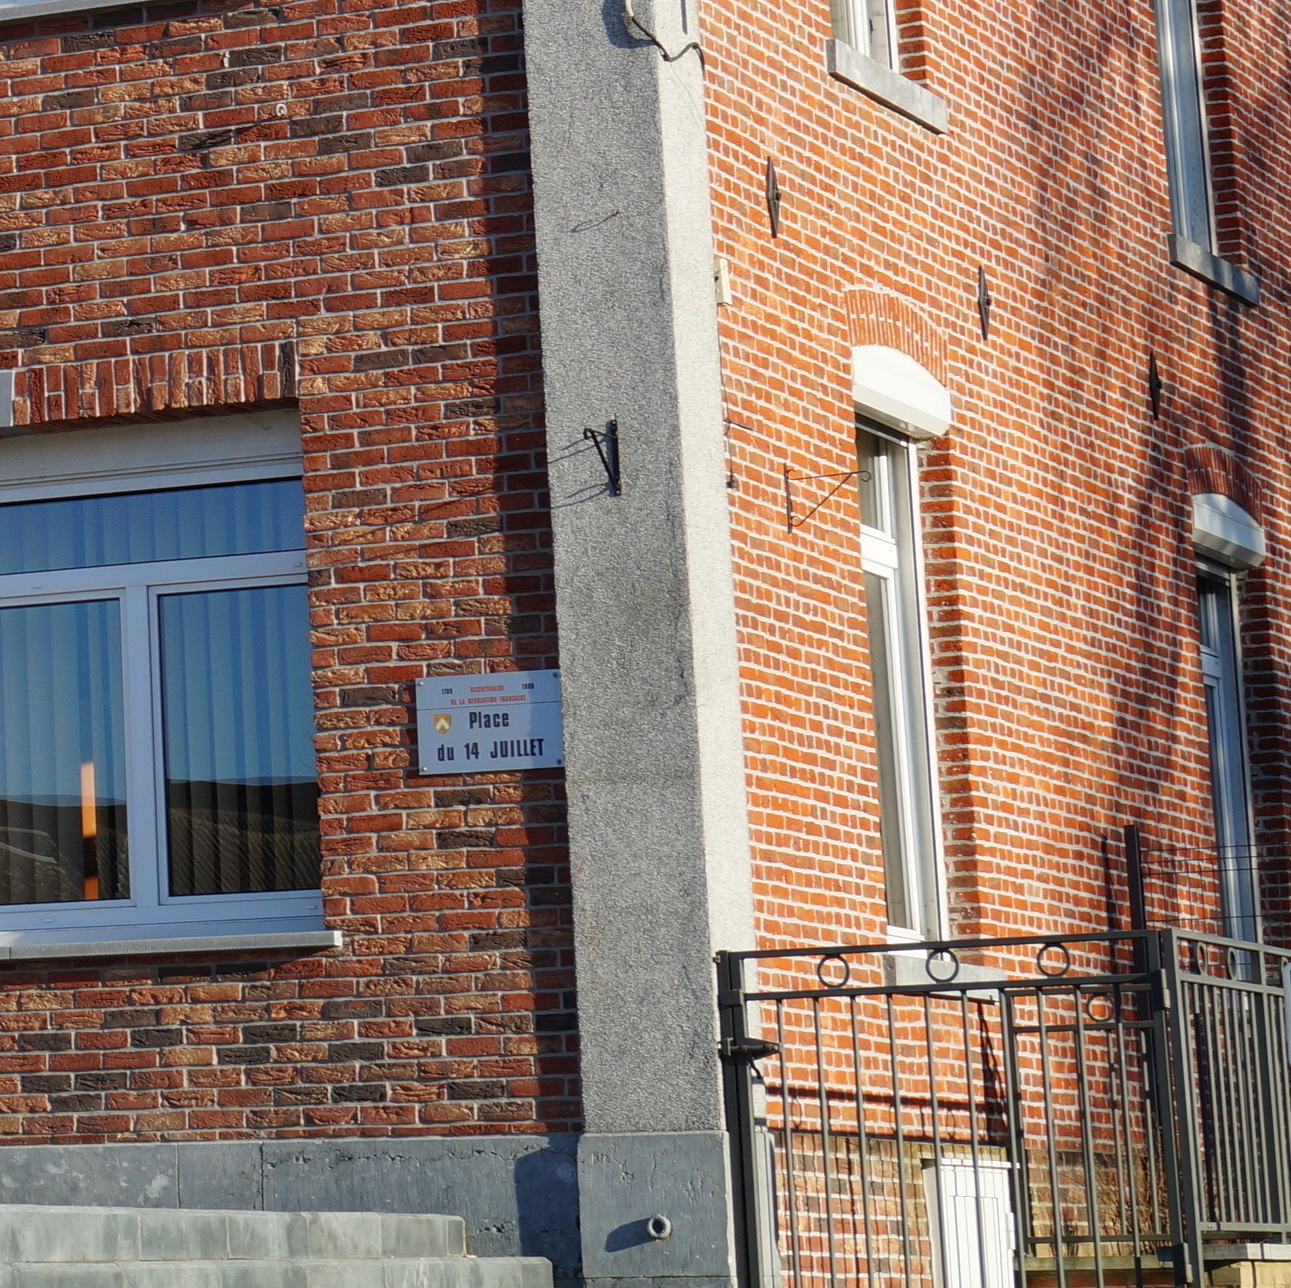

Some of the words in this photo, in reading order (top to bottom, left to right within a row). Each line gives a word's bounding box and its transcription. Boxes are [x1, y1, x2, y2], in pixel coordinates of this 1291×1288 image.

[469, 712, 510, 729] Place
[437, 744, 455, 762] du
[464, 742, 480, 760] 14
[490, 738, 544, 759] JUILLET
